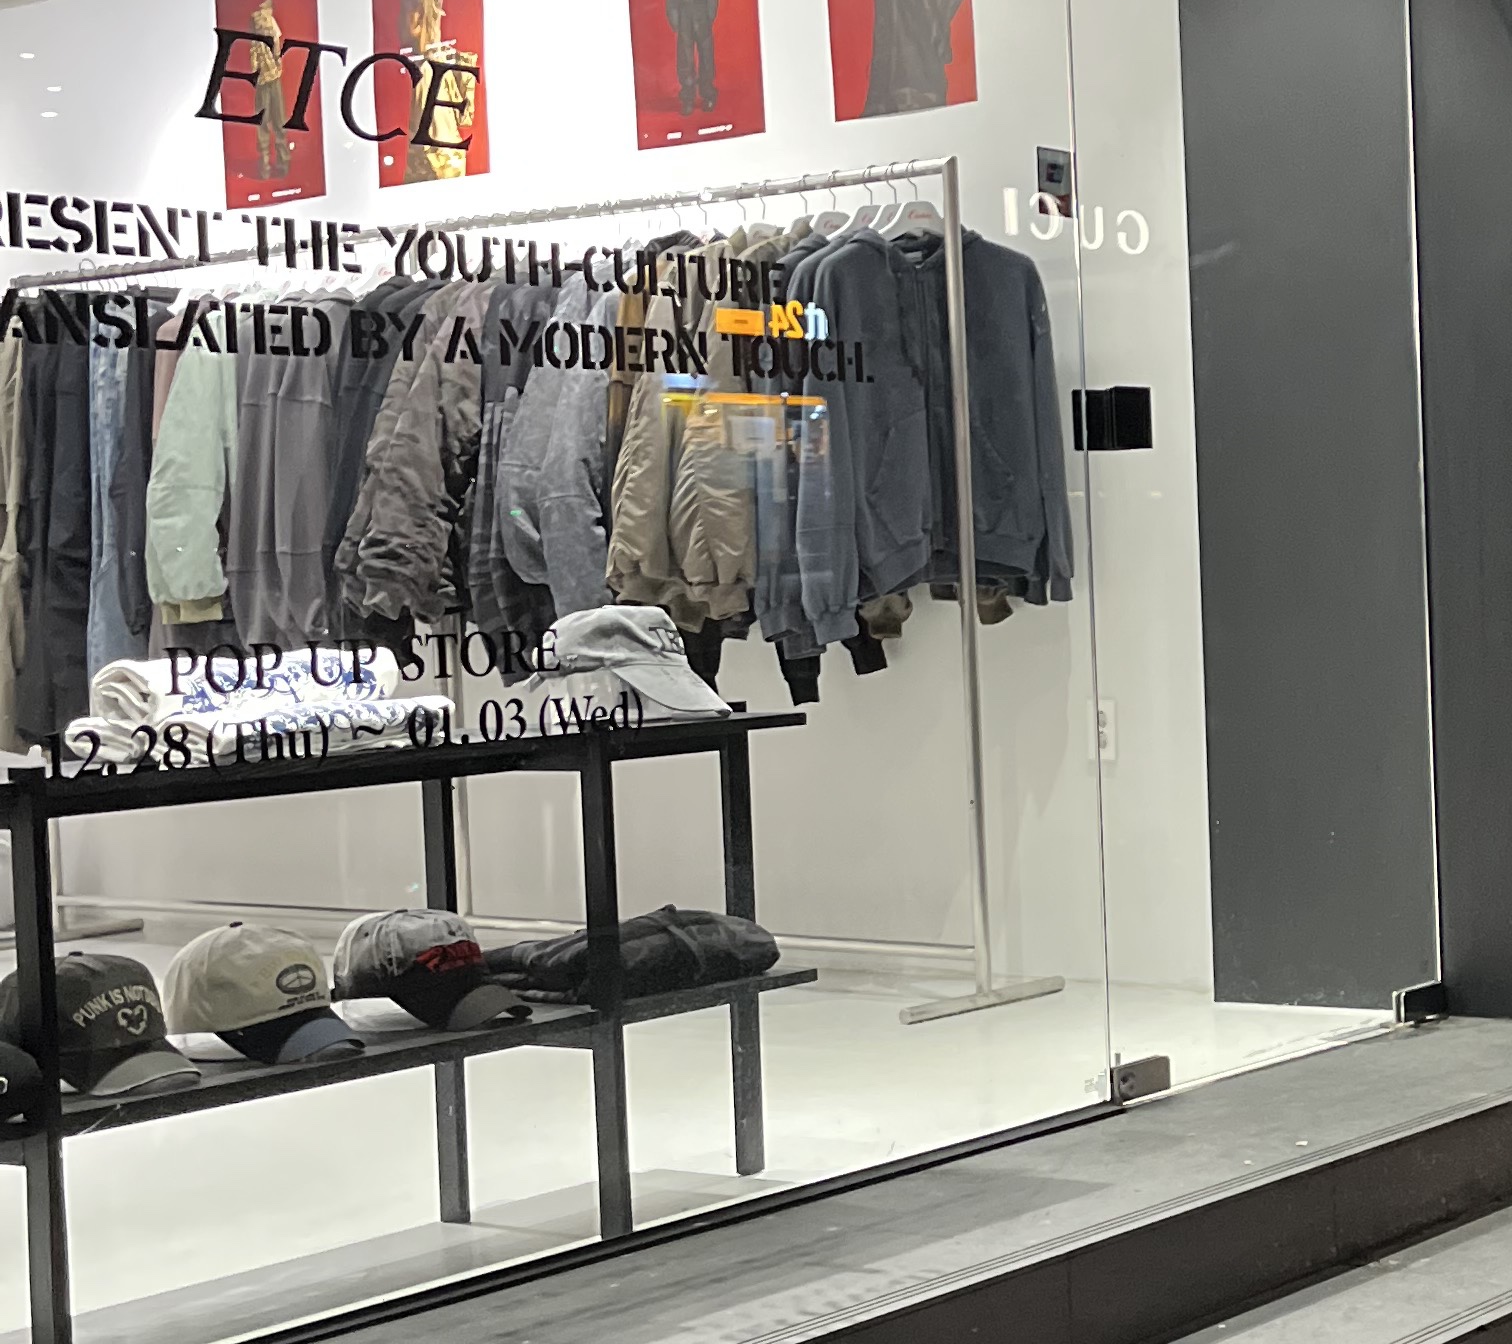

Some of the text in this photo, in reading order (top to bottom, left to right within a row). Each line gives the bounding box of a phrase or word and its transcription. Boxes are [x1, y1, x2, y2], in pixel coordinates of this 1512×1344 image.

[195, 27, 480, 152] ETCE
[0, 191, 223, 262] ESENT
[241, 213, 362, 274] THE
[349, 309, 427, 362] BY
[443, 315, 484, 365] A
[499, 318, 709, 376] MODERN
[720, 332, 876, 383] TOUCH.
[164, 628, 562, 697] POP UP STORE
[205, 713, 330, 776] (Thu)
[538, 689, 644, 738] (Wed)
[72, 992, 114, 1028] PUNK
